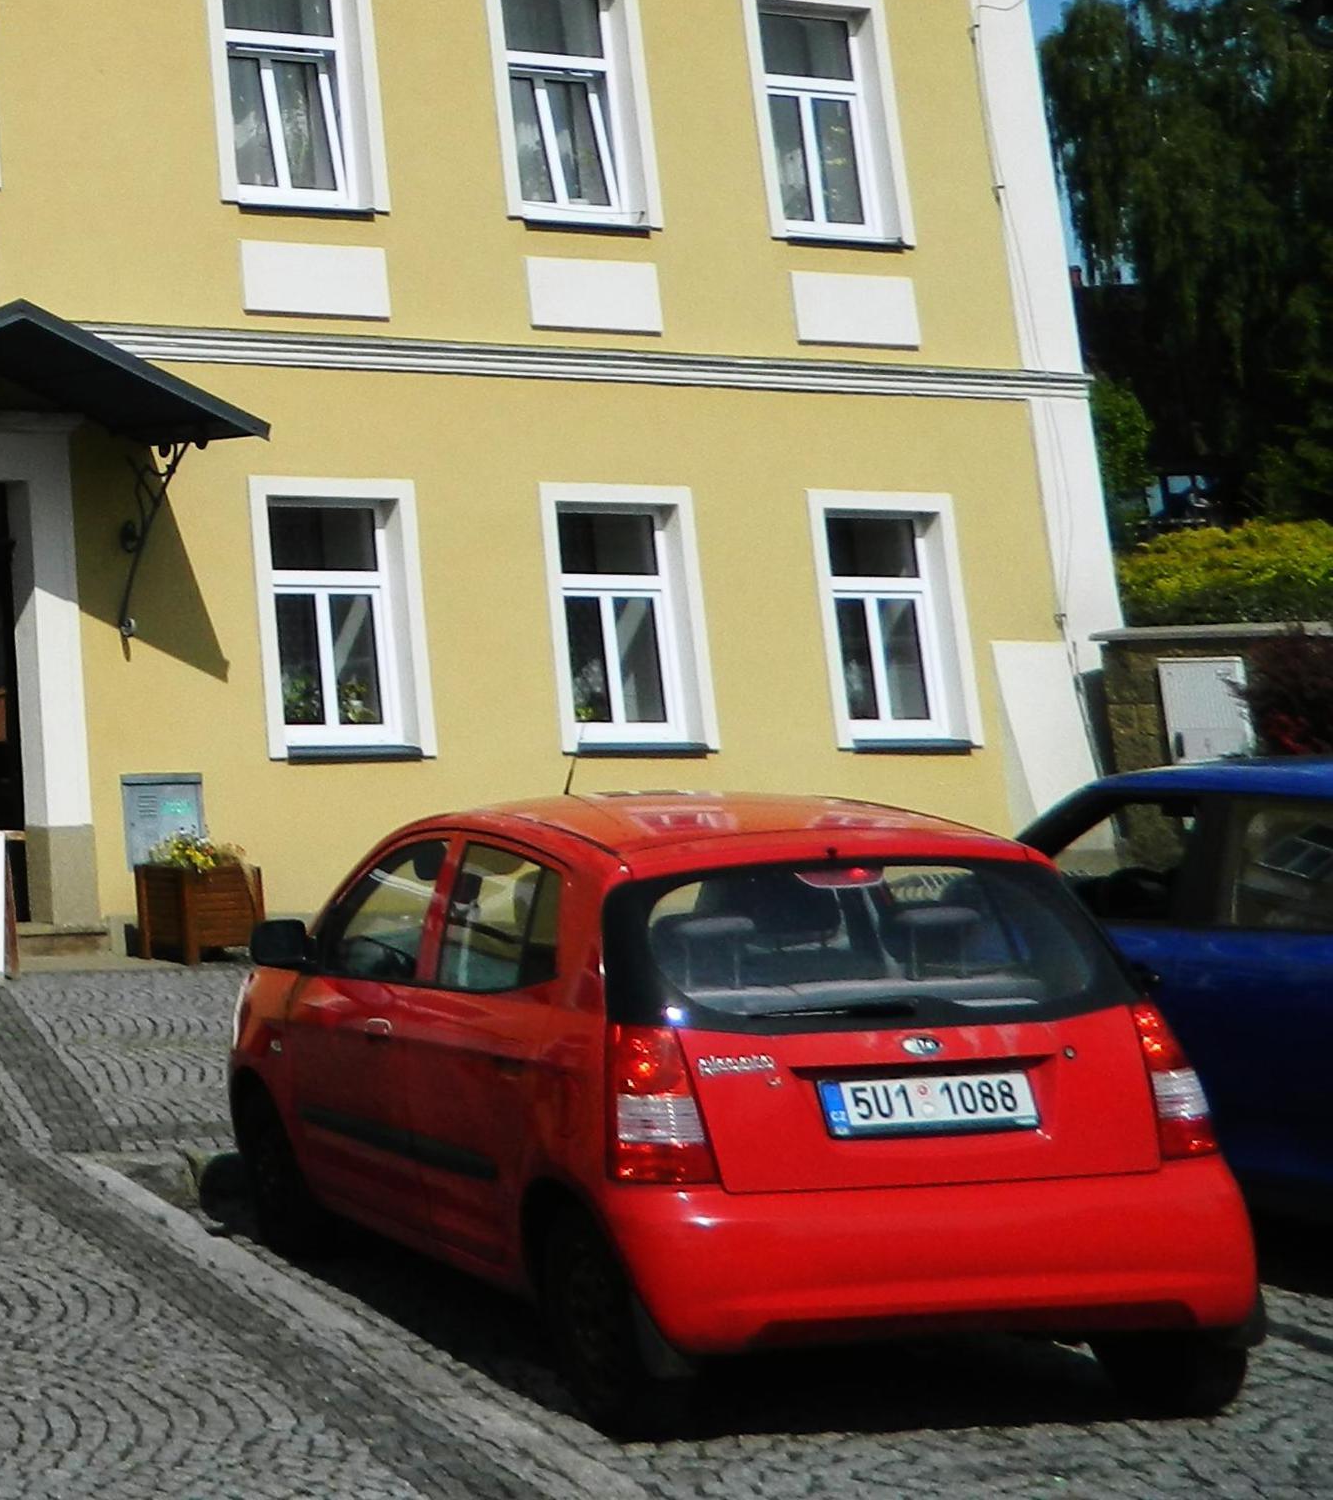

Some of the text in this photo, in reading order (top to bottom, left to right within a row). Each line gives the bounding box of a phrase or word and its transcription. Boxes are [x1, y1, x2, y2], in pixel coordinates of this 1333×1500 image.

[850, 1079, 1019, 1120] 5U1 1088
[830, 1109, 847, 1122] CZ
